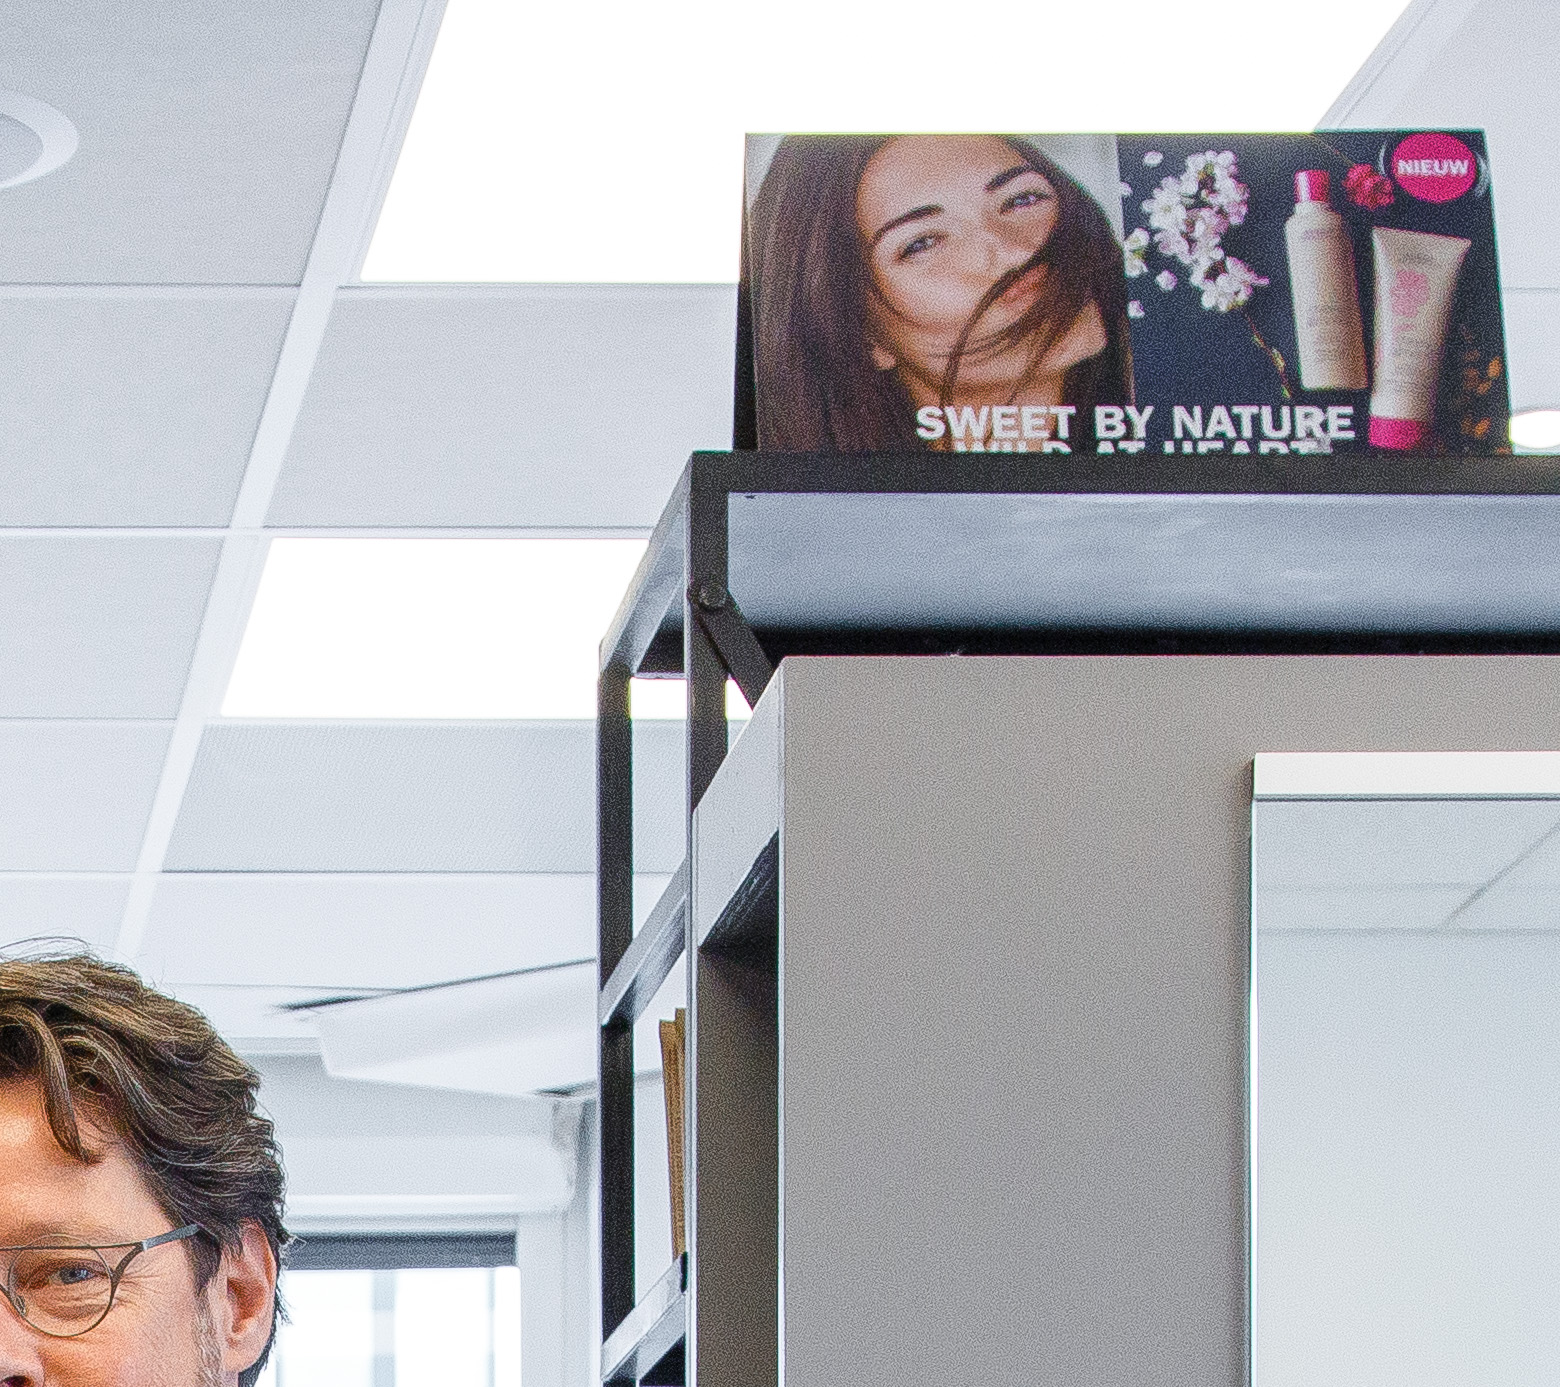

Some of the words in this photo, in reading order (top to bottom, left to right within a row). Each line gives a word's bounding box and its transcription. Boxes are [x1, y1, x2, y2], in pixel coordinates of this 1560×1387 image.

[1396, 158, 1470, 178] NIEUW
[915, 405, 1076, 439] SWEET
[1095, 405, 1156, 439] BY
[1173, 405, 1356, 439] NATURE
